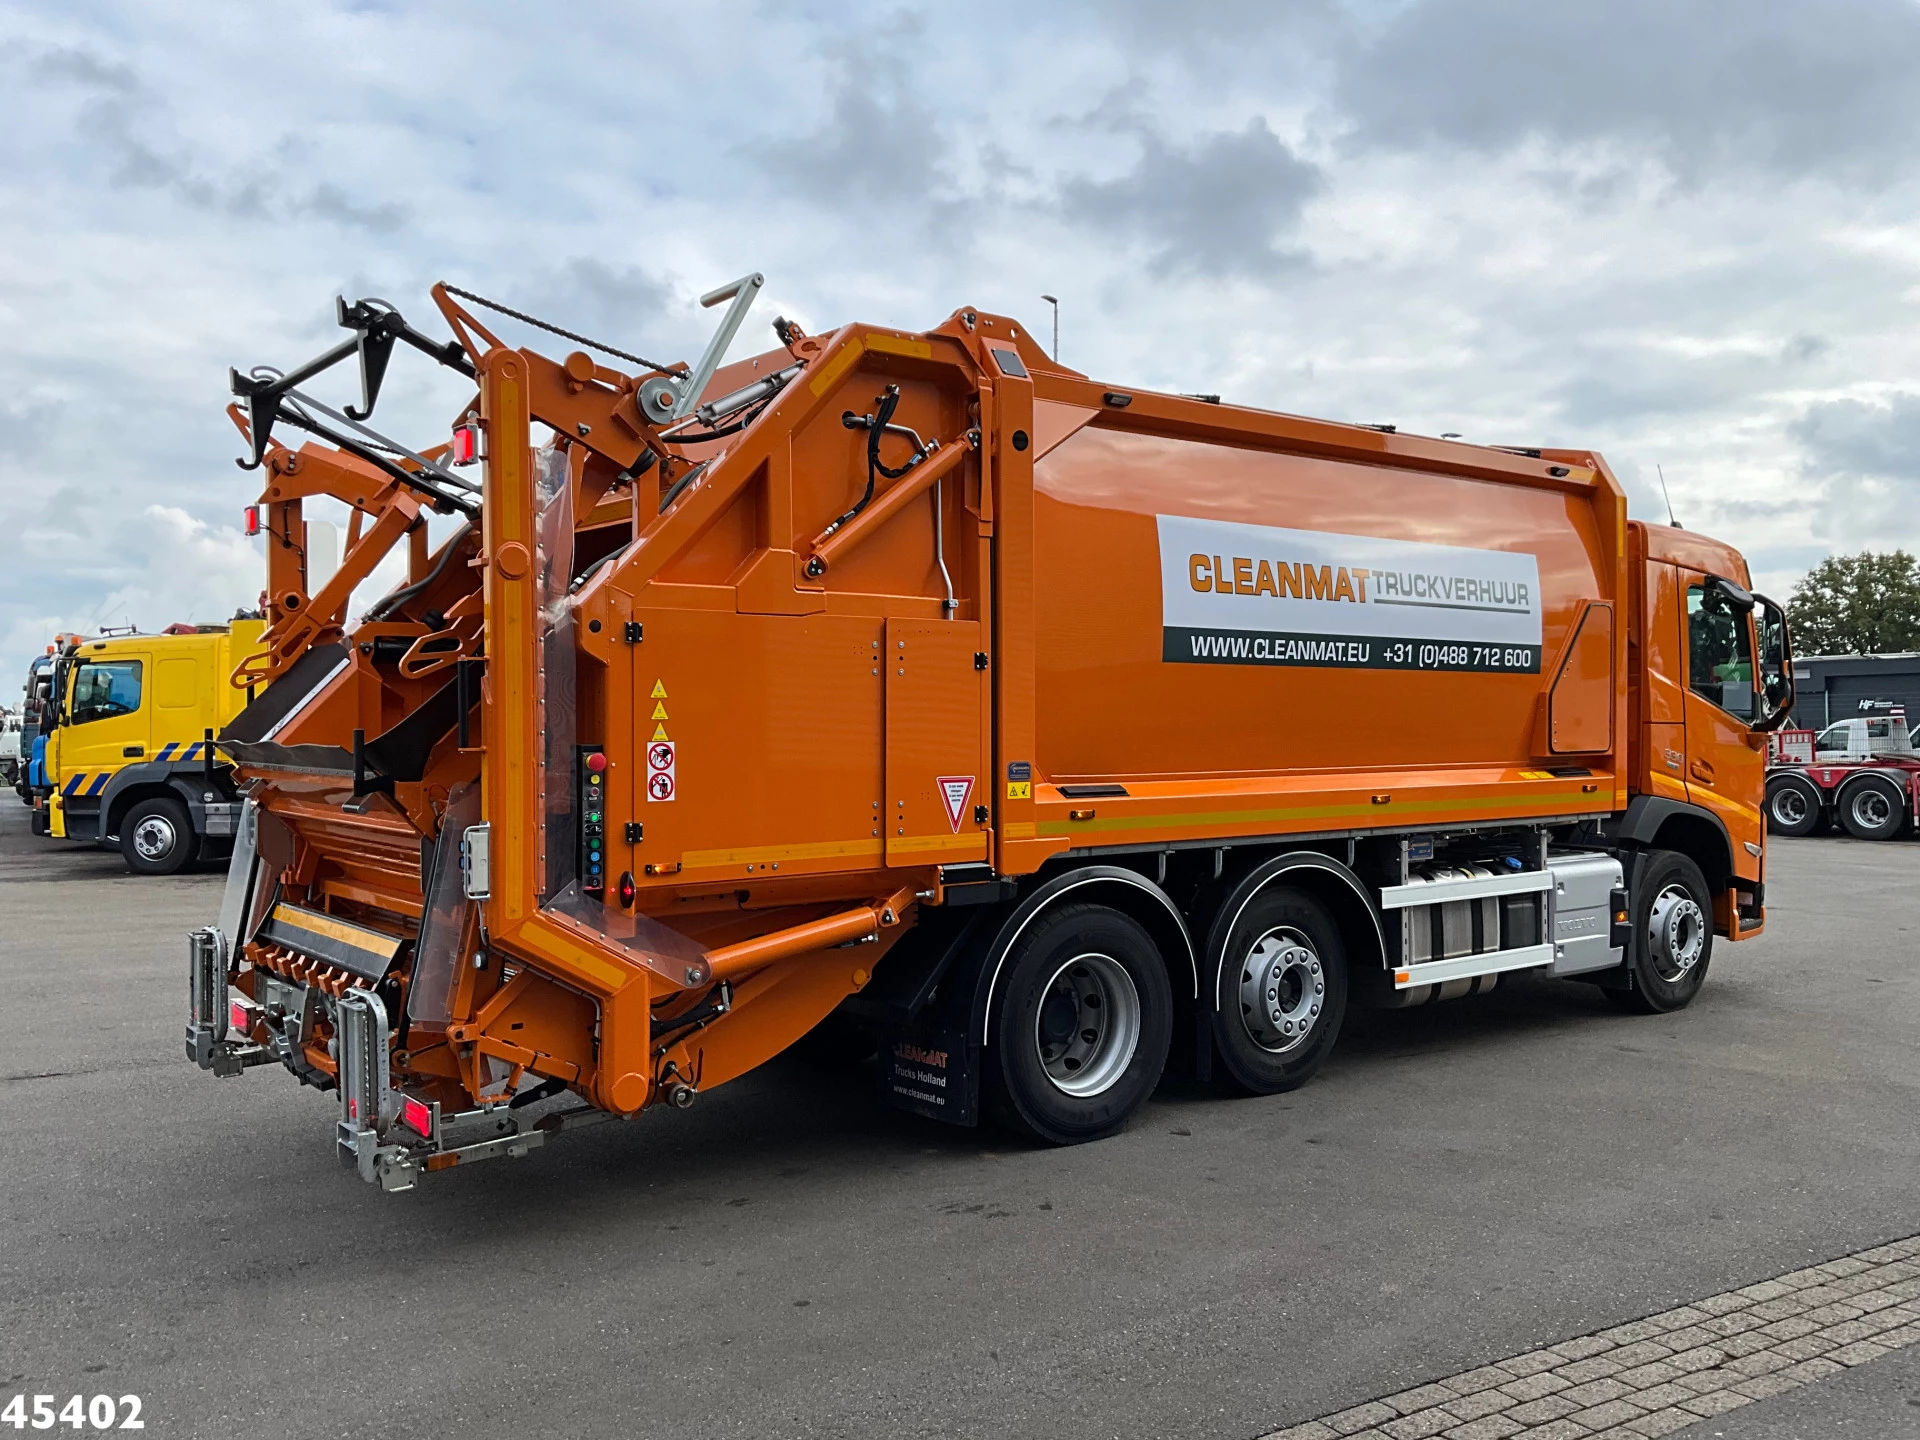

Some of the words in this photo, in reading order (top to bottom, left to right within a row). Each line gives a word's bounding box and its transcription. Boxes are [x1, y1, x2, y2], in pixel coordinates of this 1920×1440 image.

[1189, 553, 1370, 603] CLEANMAT
[1372, 570, 1529, 606] TRUCKVERHUUR
[1191, 635, 1370, 662] WWW.CLEANMAT.EU
[1384, 644, 1413, 663] +31
[1419, 644, 1468, 668] (0)488
[1473, 648, 1500, 666] 712
[1504, 649, 1531, 667] 600
[1858, 699, 1874, 710] HF
[894, 1064, 916, 1080] Trucks
[917, 1070, 946, 1087] Holland
[893, 1085, 945, 1105] www.cleanmat.eu
